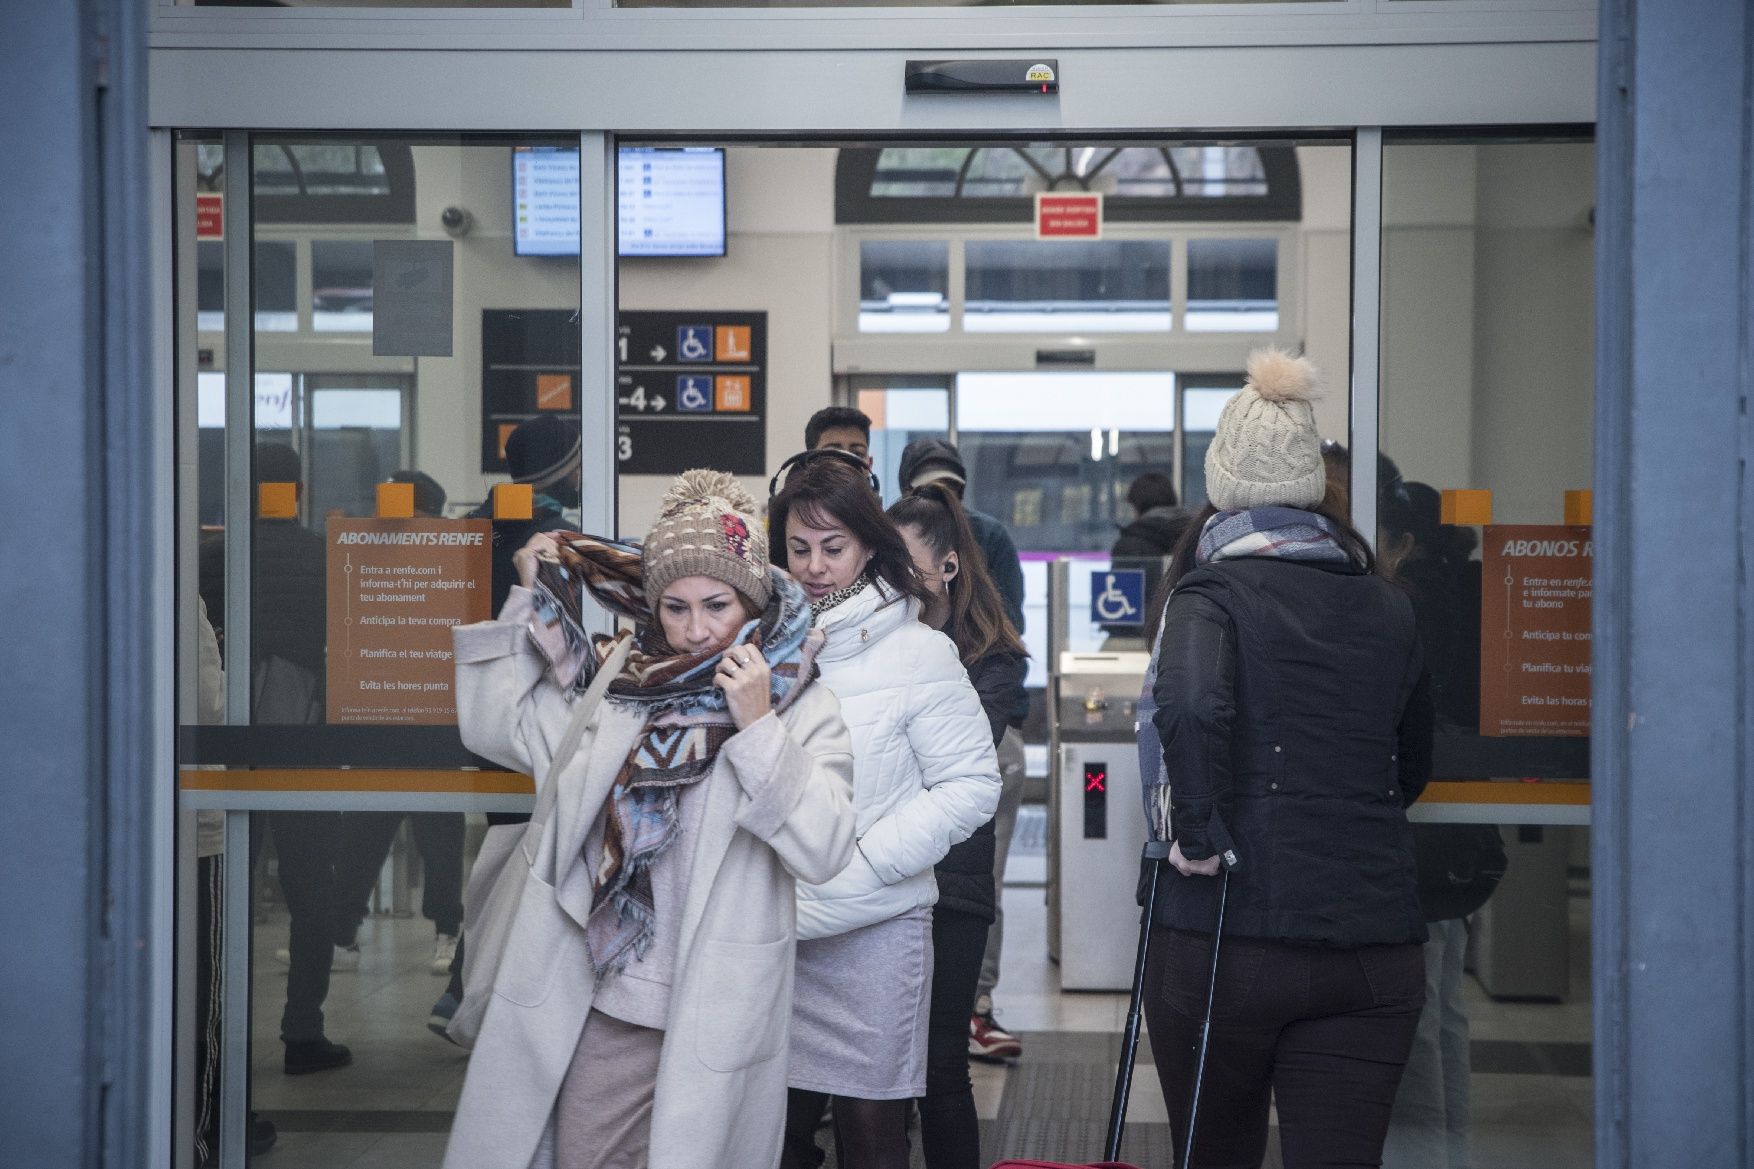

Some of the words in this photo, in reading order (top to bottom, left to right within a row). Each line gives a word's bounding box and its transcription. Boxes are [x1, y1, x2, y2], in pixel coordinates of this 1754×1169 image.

[619, 336, 628, 361] 1
[619, 435, 632, 461] 3
[337, 532, 437, 545] ABONAMENTS
[438, 532, 484, 546] RENFE
[1501, 540, 1580, 557] ABONOS
[1582, 541, 1593, 557] R
[360, 565, 383, 574] Entra
[393, 566, 436, 575] renfe.com
[438, 566, 442, 574] i
[414, 582, 432, 591] per
[431, 579, 465, 591] adquirir
[467, 579, 476, 589] el
[1523, 577, 1548, 586] Entra
[1550, 578, 1562, 586] en
[360, 593, 374, 602] teu
[376, 593, 426, 602] abonament
[1523, 600, 1533, 608] tu
[1535, 599, 1564, 609] abono
[360, 616, 396, 627] Anticipa
[398, 616, 406, 625] la
[408, 616, 427, 625] teva
[429, 617, 461, 627] compra
[1522, 630, 1561, 641] Anticipa
[1563, 631, 1572, 640] tu
[360, 649, 397, 658] Planifica
[399, 649, 407, 658] el
[409, 650, 424, 659] teu
[425, 650, 453, 661] viatge
[1522, 662, 1562, 672] Planifica
[1564, 663, 1574, 673] tu
[360, 680, 381, 690] Evita
[383, 681, 396, 690] les
[398, 681, 422, 690] hores
[423, 682, 449, 692] punta
[1522, 695, 1545, 705] Evita
[1547, 696, 1560, 705] las
[1562, 696, 1588, 705] horas
